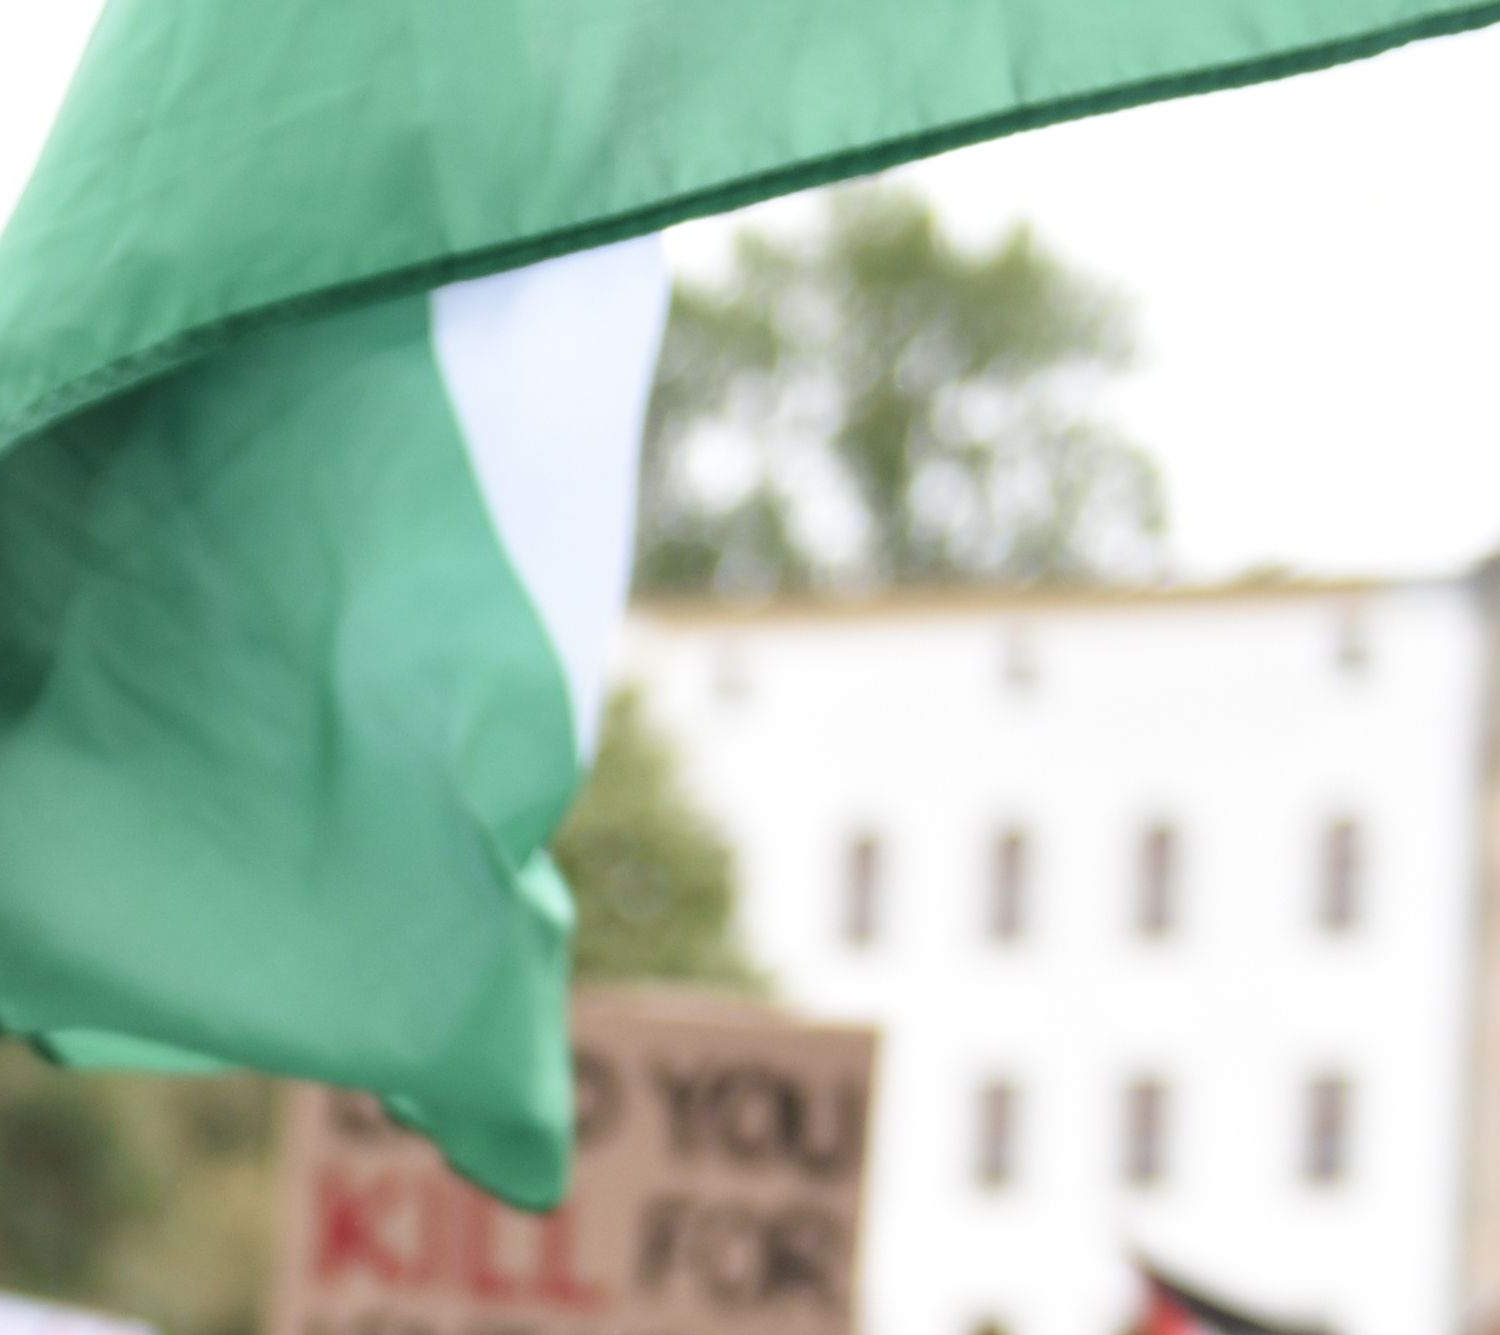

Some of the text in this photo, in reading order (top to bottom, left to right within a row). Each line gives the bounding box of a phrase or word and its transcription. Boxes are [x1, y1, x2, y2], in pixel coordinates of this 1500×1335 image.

[645, 1058, 864, 1178] YOU
[314, 1164, 842, 1312] KILL FOR
